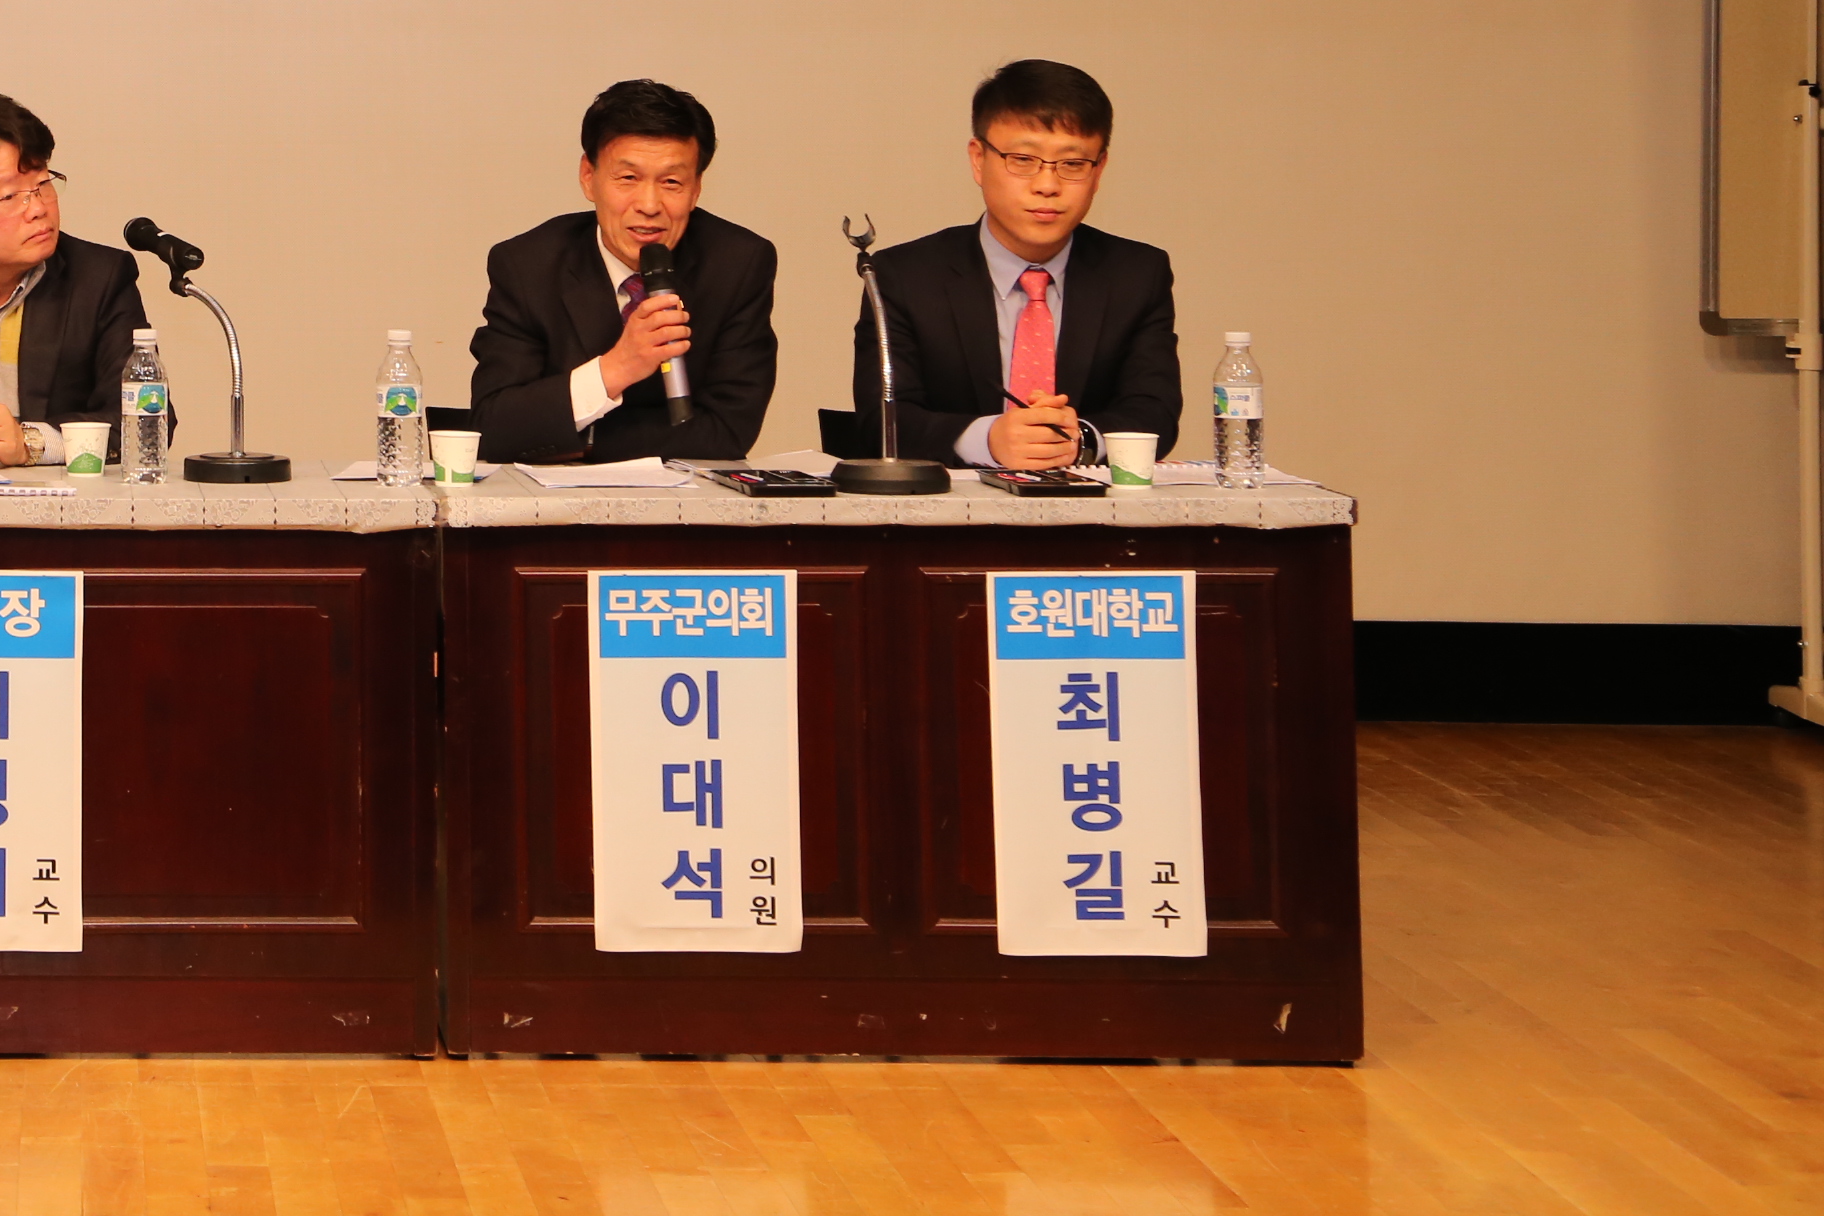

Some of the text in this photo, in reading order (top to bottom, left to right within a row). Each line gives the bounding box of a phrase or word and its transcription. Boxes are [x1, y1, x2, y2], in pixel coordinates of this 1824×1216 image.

[605, 588, 772, 636] 무주군의회
[1007, 589, 1178, 637] 호원대학교
[662, 671, 722, 918] 이대석
[1058, 672, 1124, 919] 최병길
[33, 859, 60, 924] 교수
[750, 857, 776, 925] 의원
[1152, 862, 1180, 927] 교수
